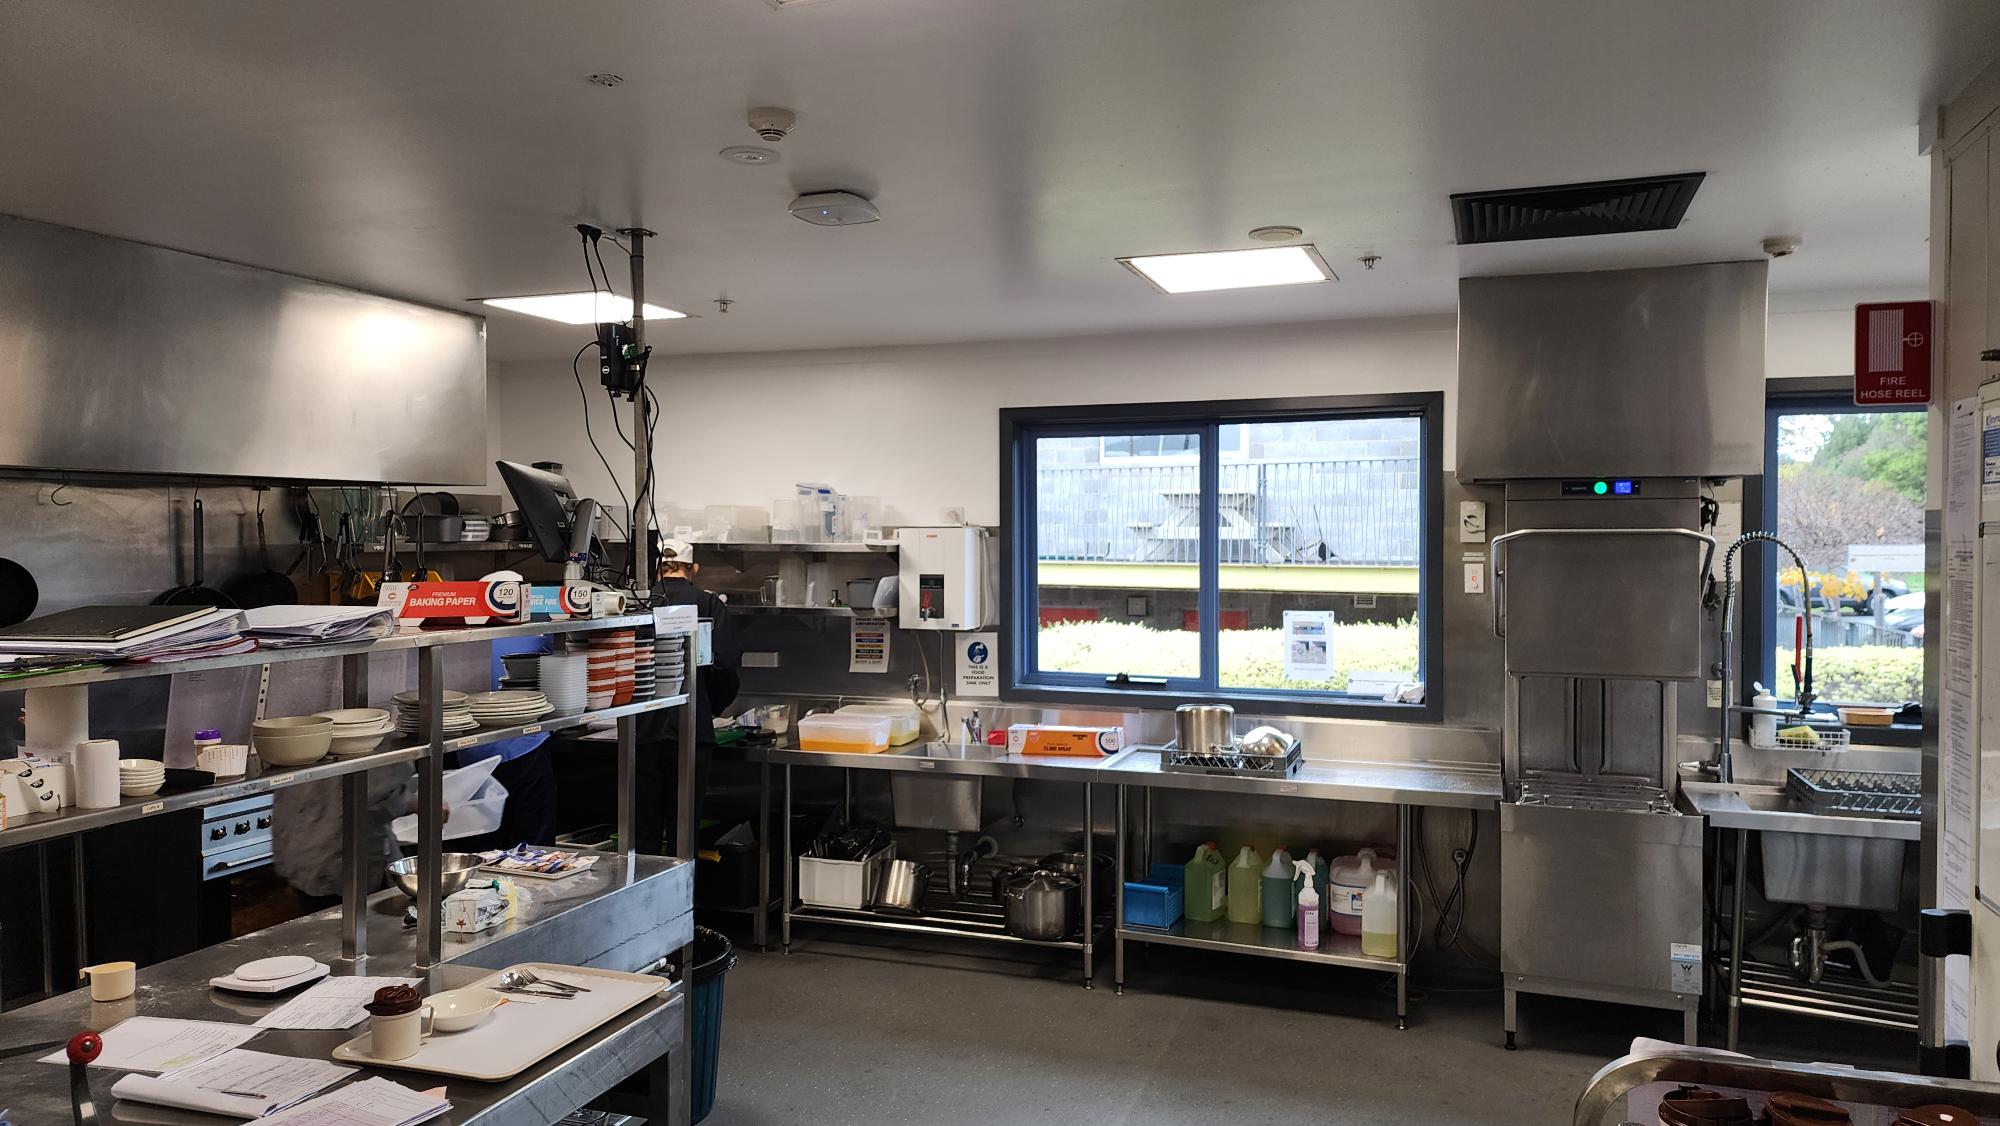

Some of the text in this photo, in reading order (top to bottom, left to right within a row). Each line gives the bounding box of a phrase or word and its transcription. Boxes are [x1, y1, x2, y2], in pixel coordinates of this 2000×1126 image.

[1880, 376, 1906, 385] FIRE
[1861, 388, 1927, 399] HOSE REEL
[498, 588, 514, 596] 120
[573, 590, 588, 598] 150
[409, 597, 477, 607] BAKING PAPER
